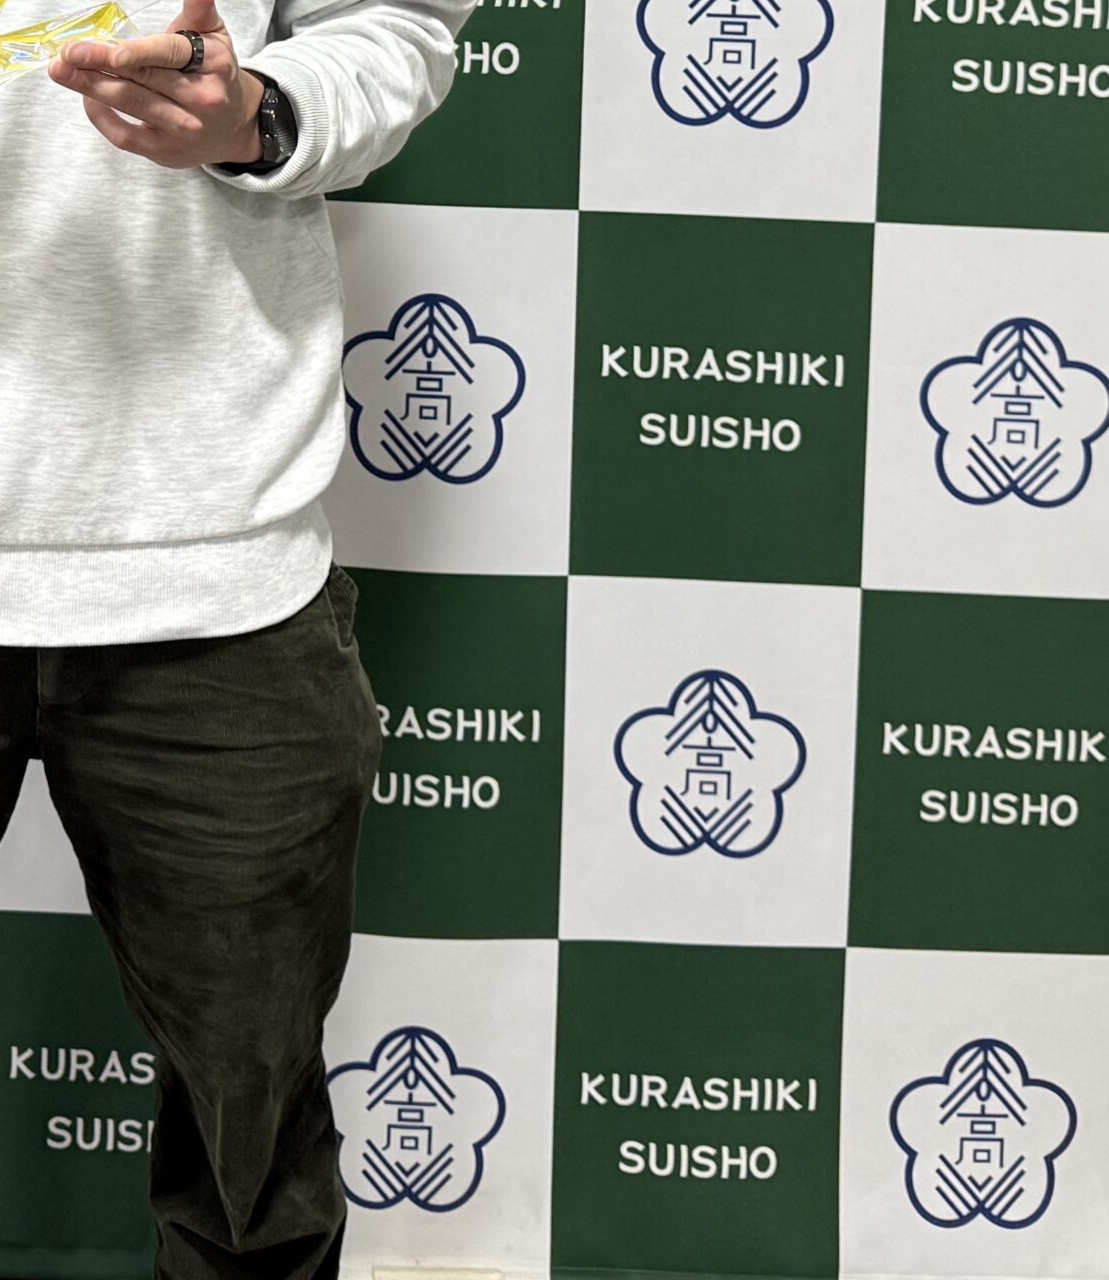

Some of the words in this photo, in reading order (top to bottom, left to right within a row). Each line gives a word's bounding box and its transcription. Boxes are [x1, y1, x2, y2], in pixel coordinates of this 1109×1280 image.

[952, 59, 1109, 98] SUISHO
[601, 344, 844, 388] KURASHIKI
[639, 412, 801, 452] SUISHO
[919, 789, 1079, 827] SUISHO
[580, 1072, 817, 1111] KURASHIKI
[618, 1140, 777, 1180] SUISHO
